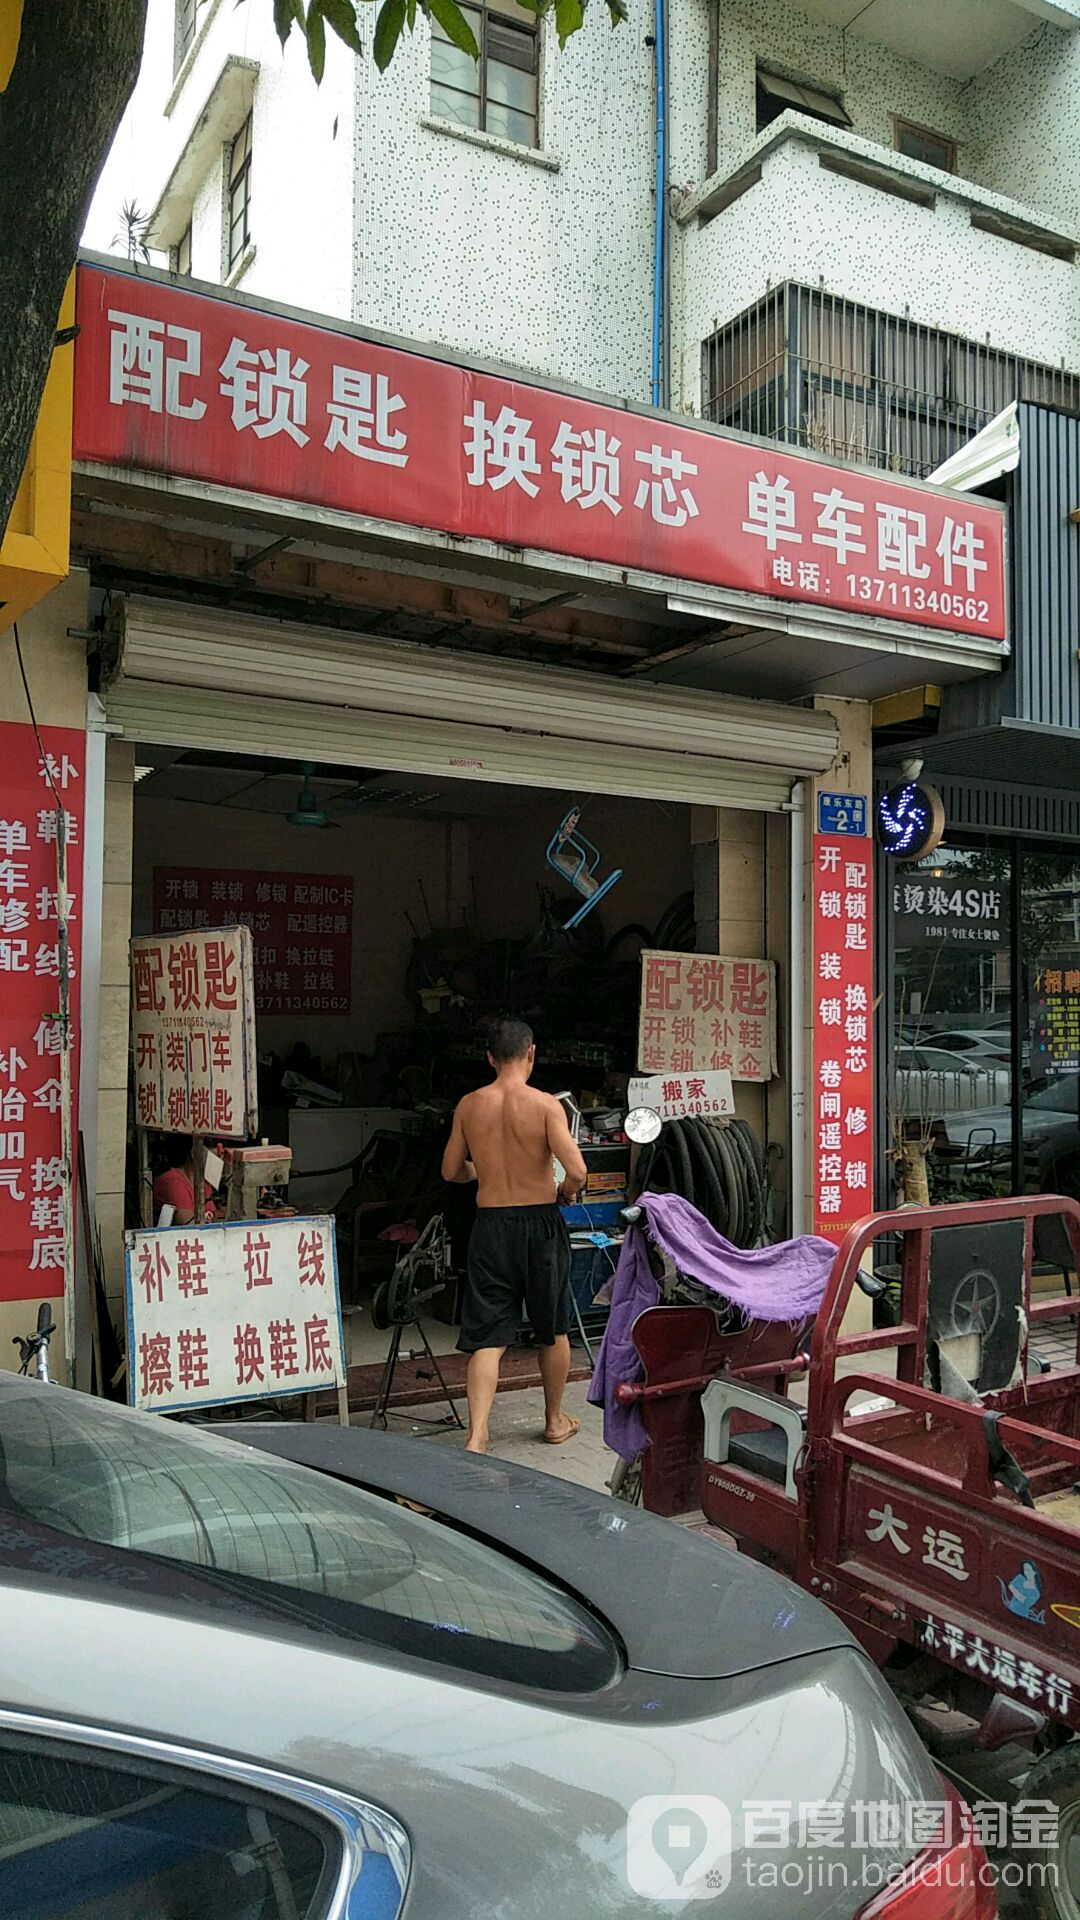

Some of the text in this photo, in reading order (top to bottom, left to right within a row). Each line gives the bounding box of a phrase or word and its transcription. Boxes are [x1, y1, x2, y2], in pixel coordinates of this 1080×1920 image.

[107, 308, 988, 592] 配锁匙 换锁芯 单车配件
[0, 819, 31, 972] 单车修配
[160, 909, 210, 928] 配锁匙
[287, 913, 348, 934] 配遥控器
[165, 879, 354, 907] 开锁 装锁 修锁 配制IC卡
[286, 947, 334, 967] 换拉链
[924, 926, 947, 937] 1981
[28, 753, 79, 1271] 补鞋 拉线 修伞 换鞋底
[134, 941, 238, 1012] 配锁匙
[258, 971, 335, 991] 补鞋 拉线
[645, 959, 768, 1017] 配锁匙
[643, 1016, 763, 1049] 开锁 补鞋
[643, 1046, 694, 1073] 装锁
[819, 846, 842, 1214] 开锁 装锁 卷闸遥控器
[844, 862, 868, 1189] 配锁匙 换锁芯 修锁
[137, 1033, 157, 1125] 开锁
[166, 1032, 186, 1128] 装锁
[189, 1032, 210, 1129] 门锁
[212, 1031, 233, 1131] 车匙
[661, 1077, 708, 1102] 搬家
[138, 1230, 326, 1303] 补鞋 拉线
[138, 1313, 333, 1398] 擦鞋 换鞋底
[865, 1503, 970, 1581] 大运
